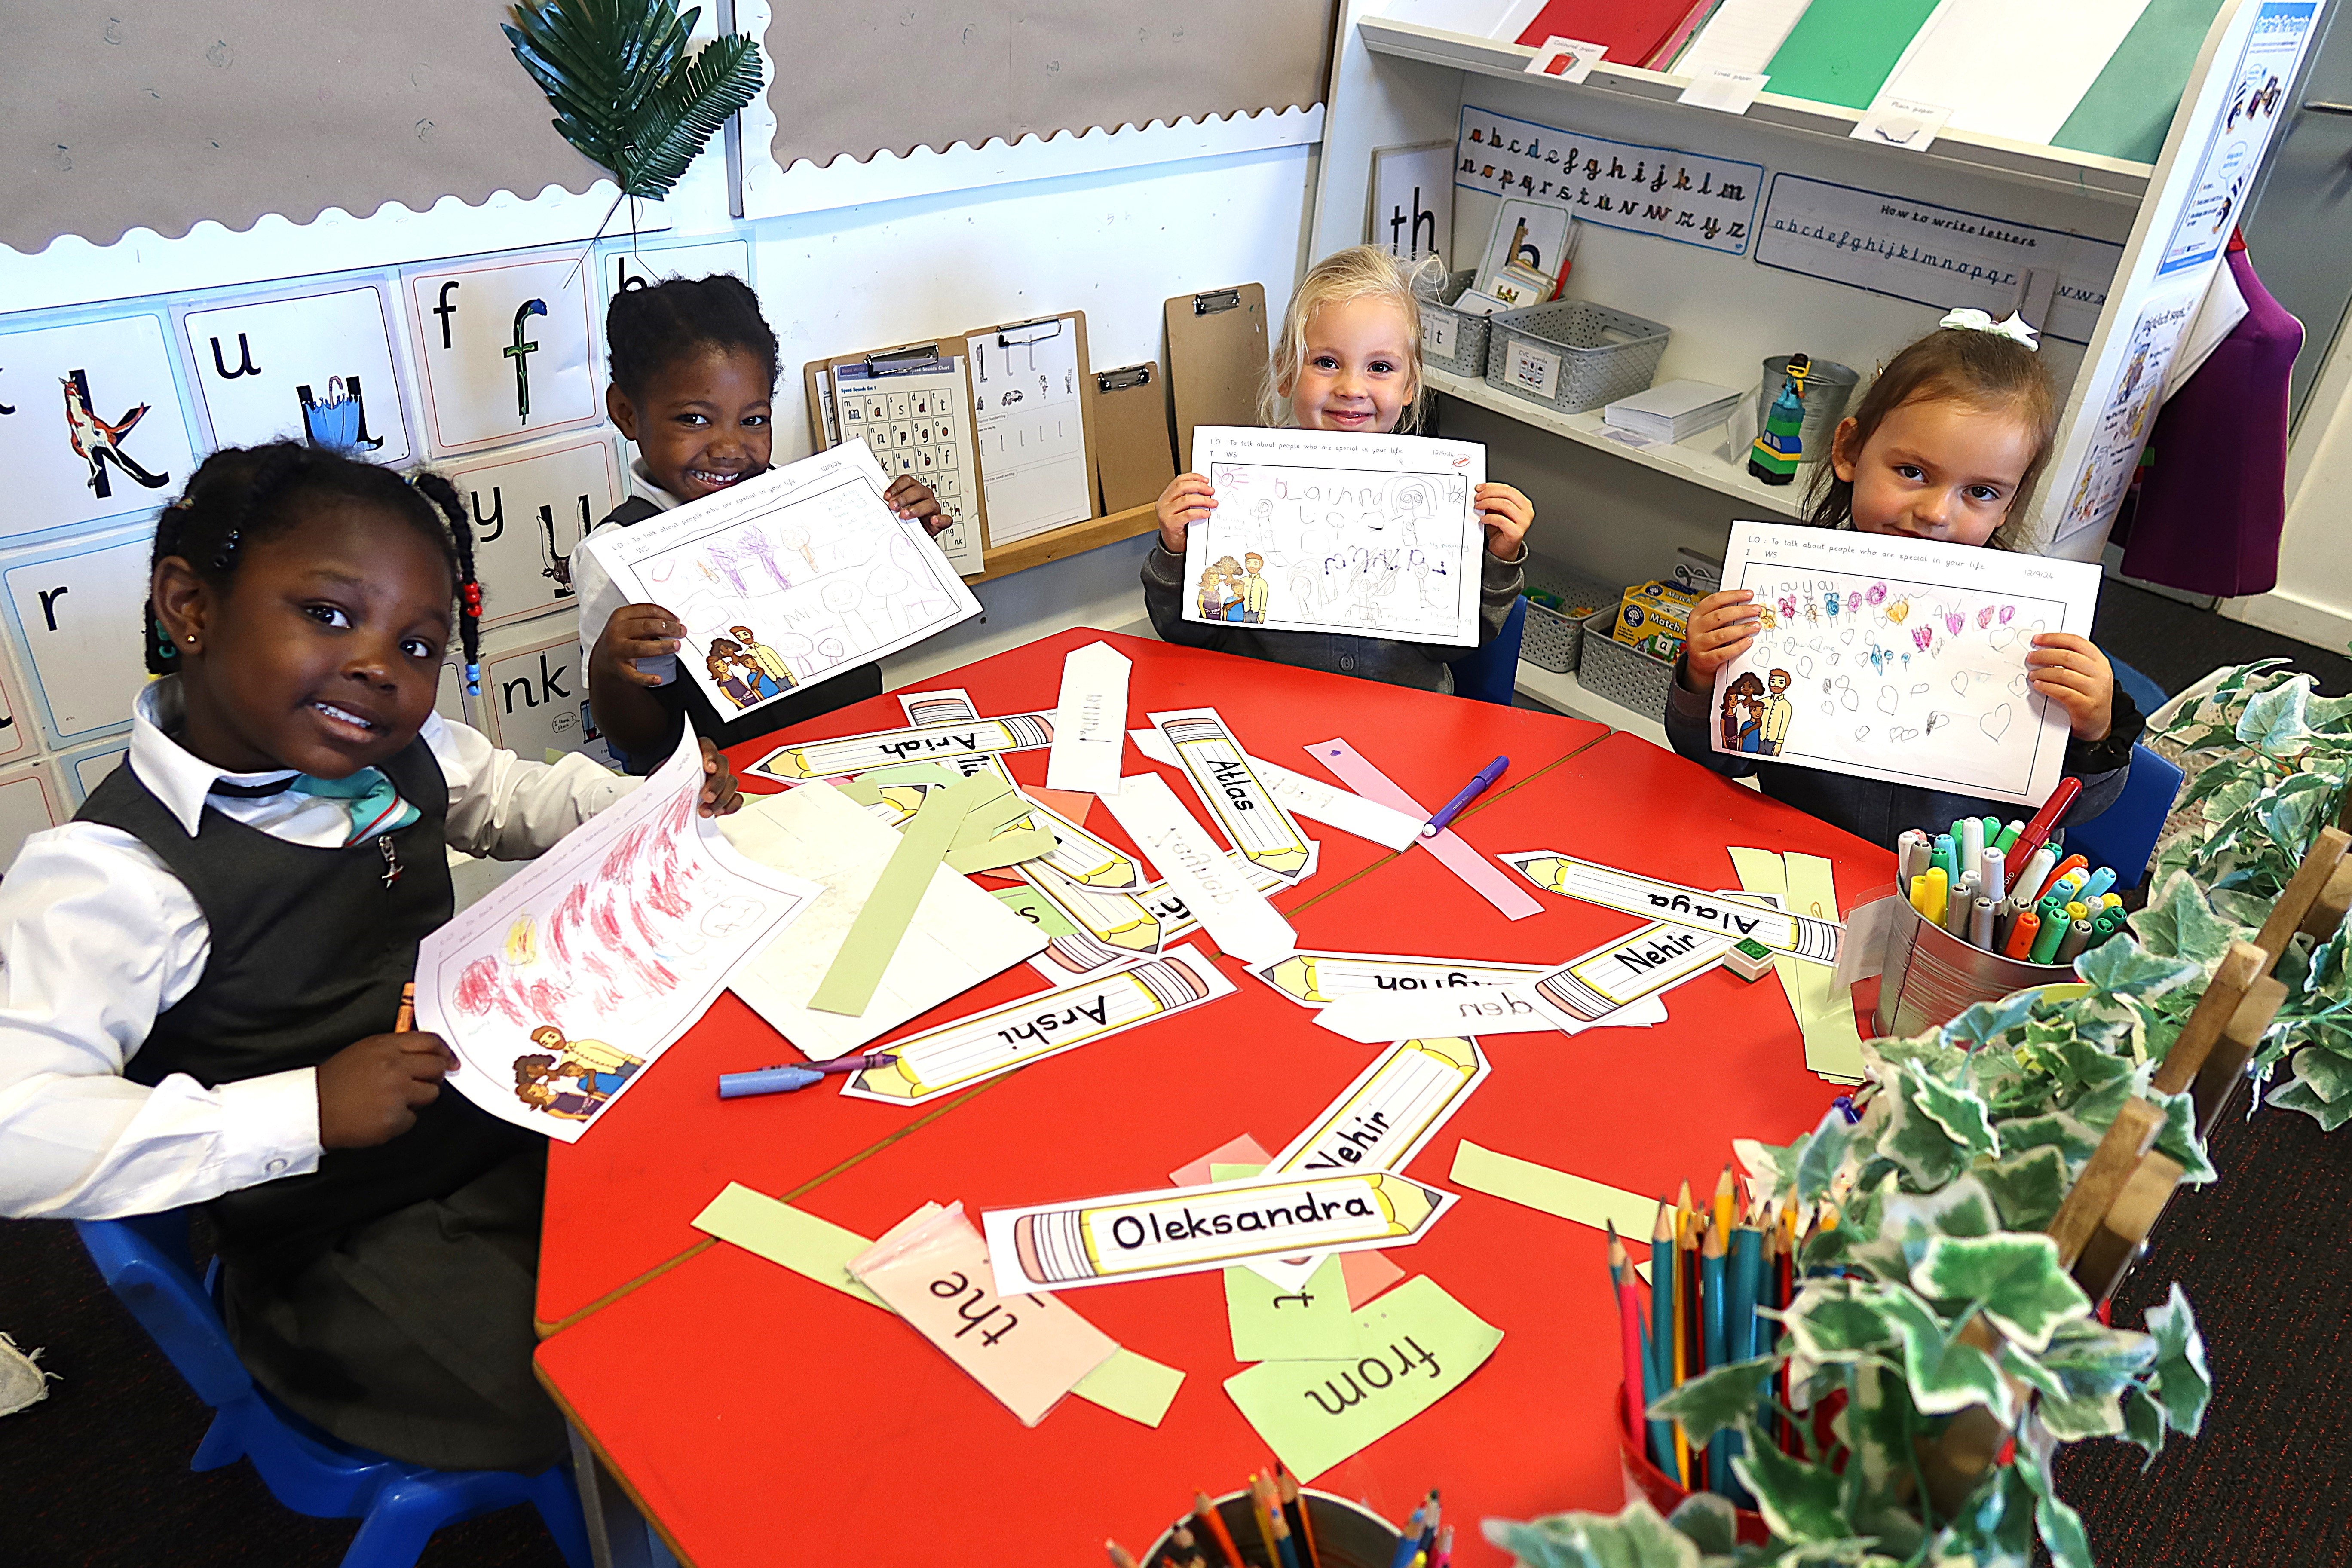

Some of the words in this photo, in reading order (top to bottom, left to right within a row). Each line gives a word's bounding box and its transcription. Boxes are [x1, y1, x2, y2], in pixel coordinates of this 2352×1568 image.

[1880, 205, 1909, 218] How
[1912, 212, 1929, 223] to
[1933, 217, 1975, 235] write
[1978, 226, 2037, 248] letters
[433, 281, 459, 349] f
[209, 333, 261, 379] u
[912, 392, 916, 401] d
[472, 487, 504, 542] y
[660, 523, 679, 532] about
[682, 513, 702, 526] people
[705, 506, 719, 514] who
[735, 492, 757, 503] special
[769, 484, 781, 493] your
[946, 528, 954, 536] ng
[955, 537, 962, 545] nk
[1829, 546, 1855, 554] people
[1899, 553, 1927, 563] special
[38, 586, 68, 631] r
[1666, 591, 1692, 603] Match
[1650, 612, 1681, 632] Match
[1660, 641, 1668, 651] a
[502, 654, 571, 714] nk
[879, 733, 976, 759] Ariah
[1206, 760, 1254, 811] Atlas
[1648, 893, 1759, 934] Alaya
[1614, 932, 1695, 976] Nehir
[1000, 995, 1107, 1051] Arshi
[1112, 1191, 1374, 1250] Oleksandra
[930, 1271, 1018, 1347] the
[1304, 1335, 1442, 1415] from
